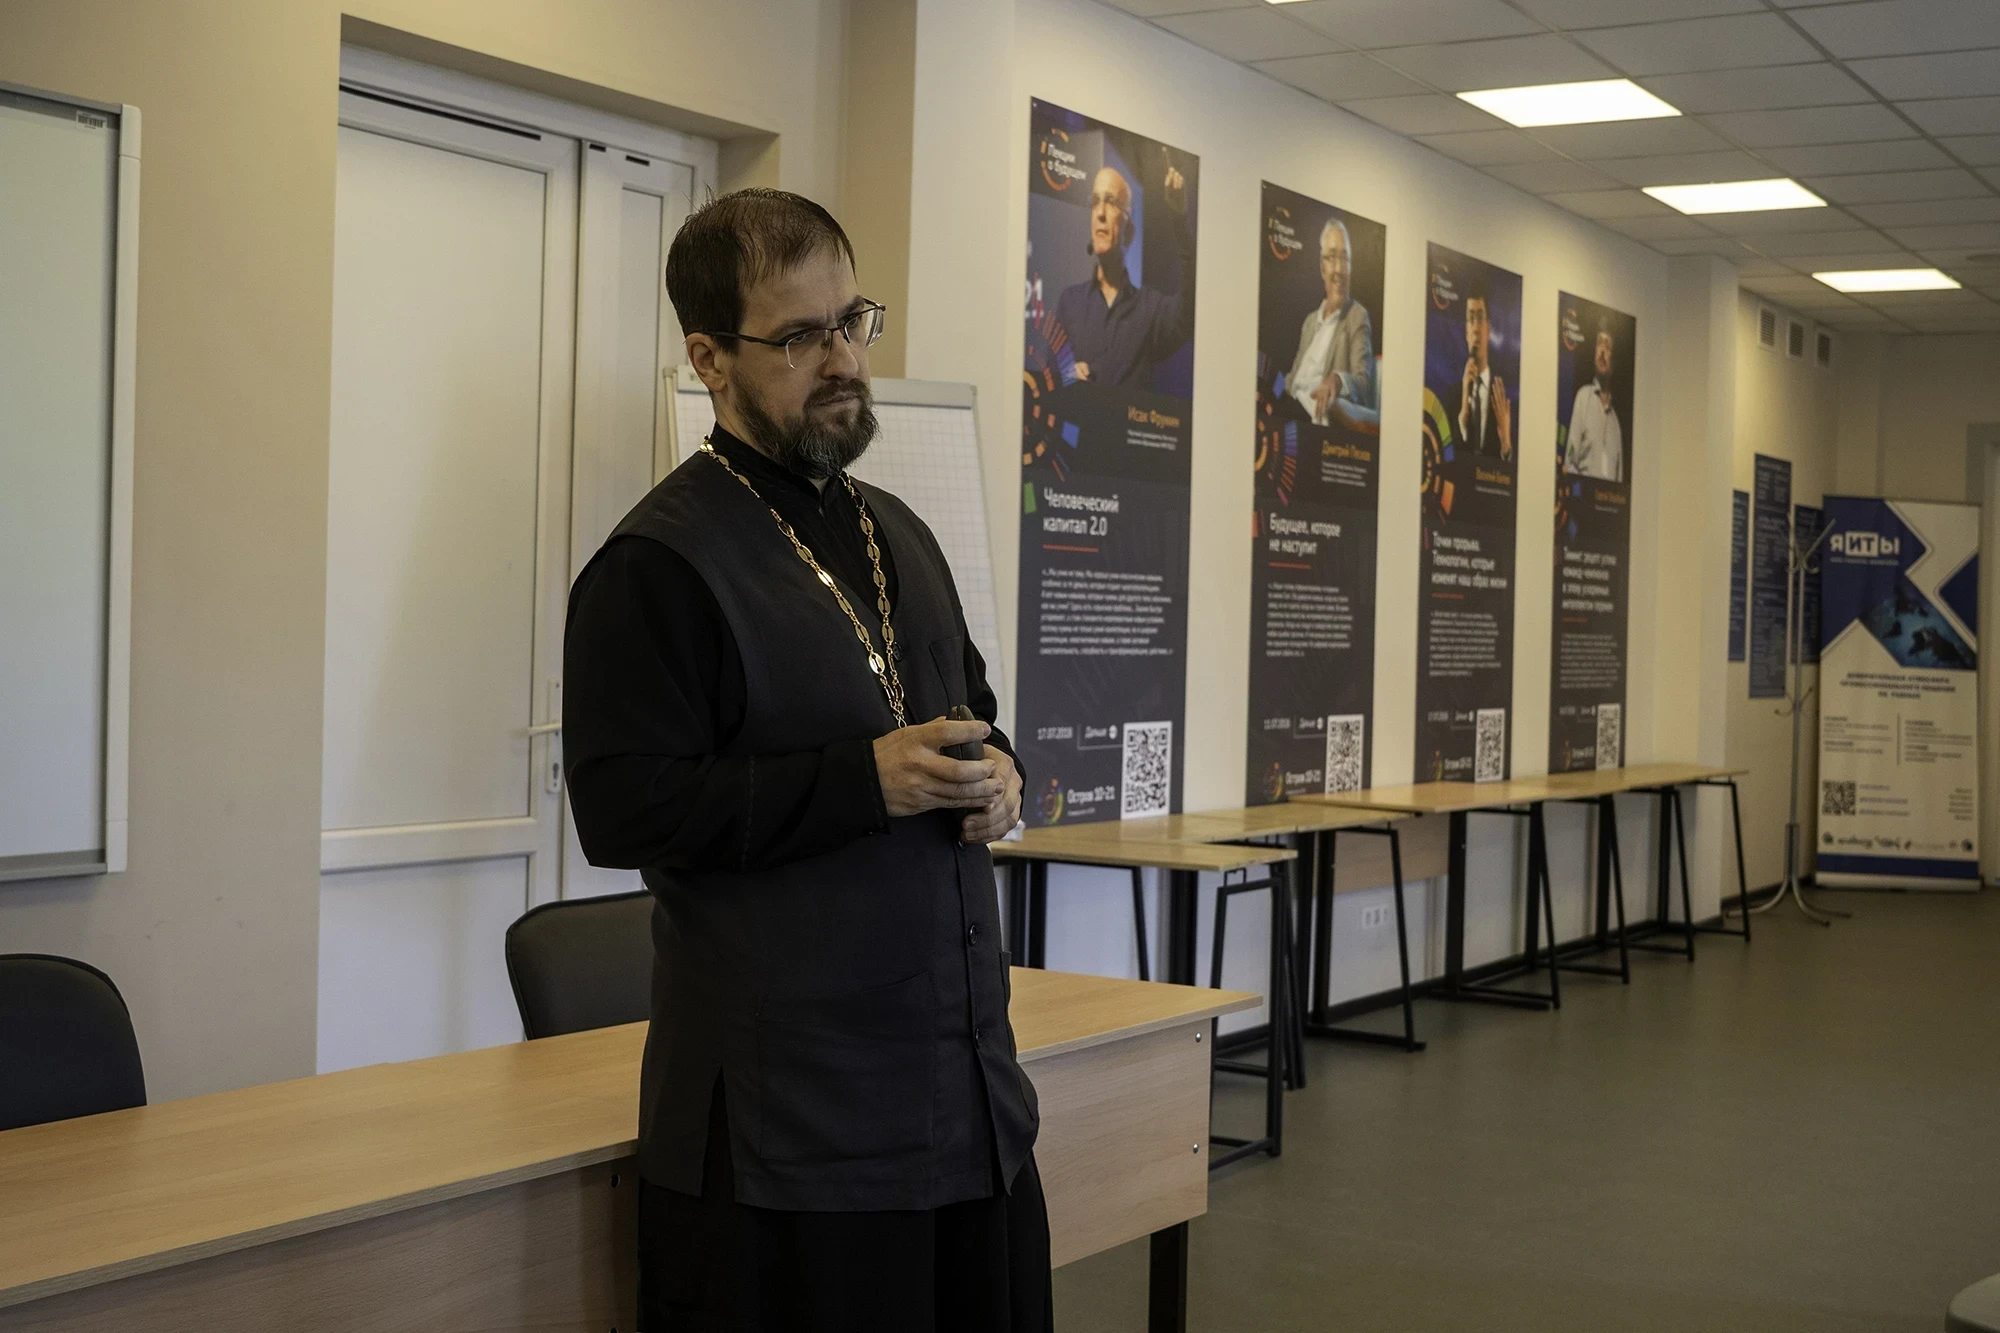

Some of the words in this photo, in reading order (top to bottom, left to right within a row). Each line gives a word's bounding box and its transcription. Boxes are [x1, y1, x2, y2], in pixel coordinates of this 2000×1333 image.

[1043, 487, 1119, 513] Человеческий
[1043, 516, 1087, 534] капитал
[1089, 515, 1108, 536] 2.0
[1269, 512, 1309, 536] Будущее,
[1310, 521, 1341, 539] которое
[1269, 538, 1280, 552] не
[1281, 540, 1318, 557] наступит
[1830, 531, 1900, 557] ЯИТЫ
